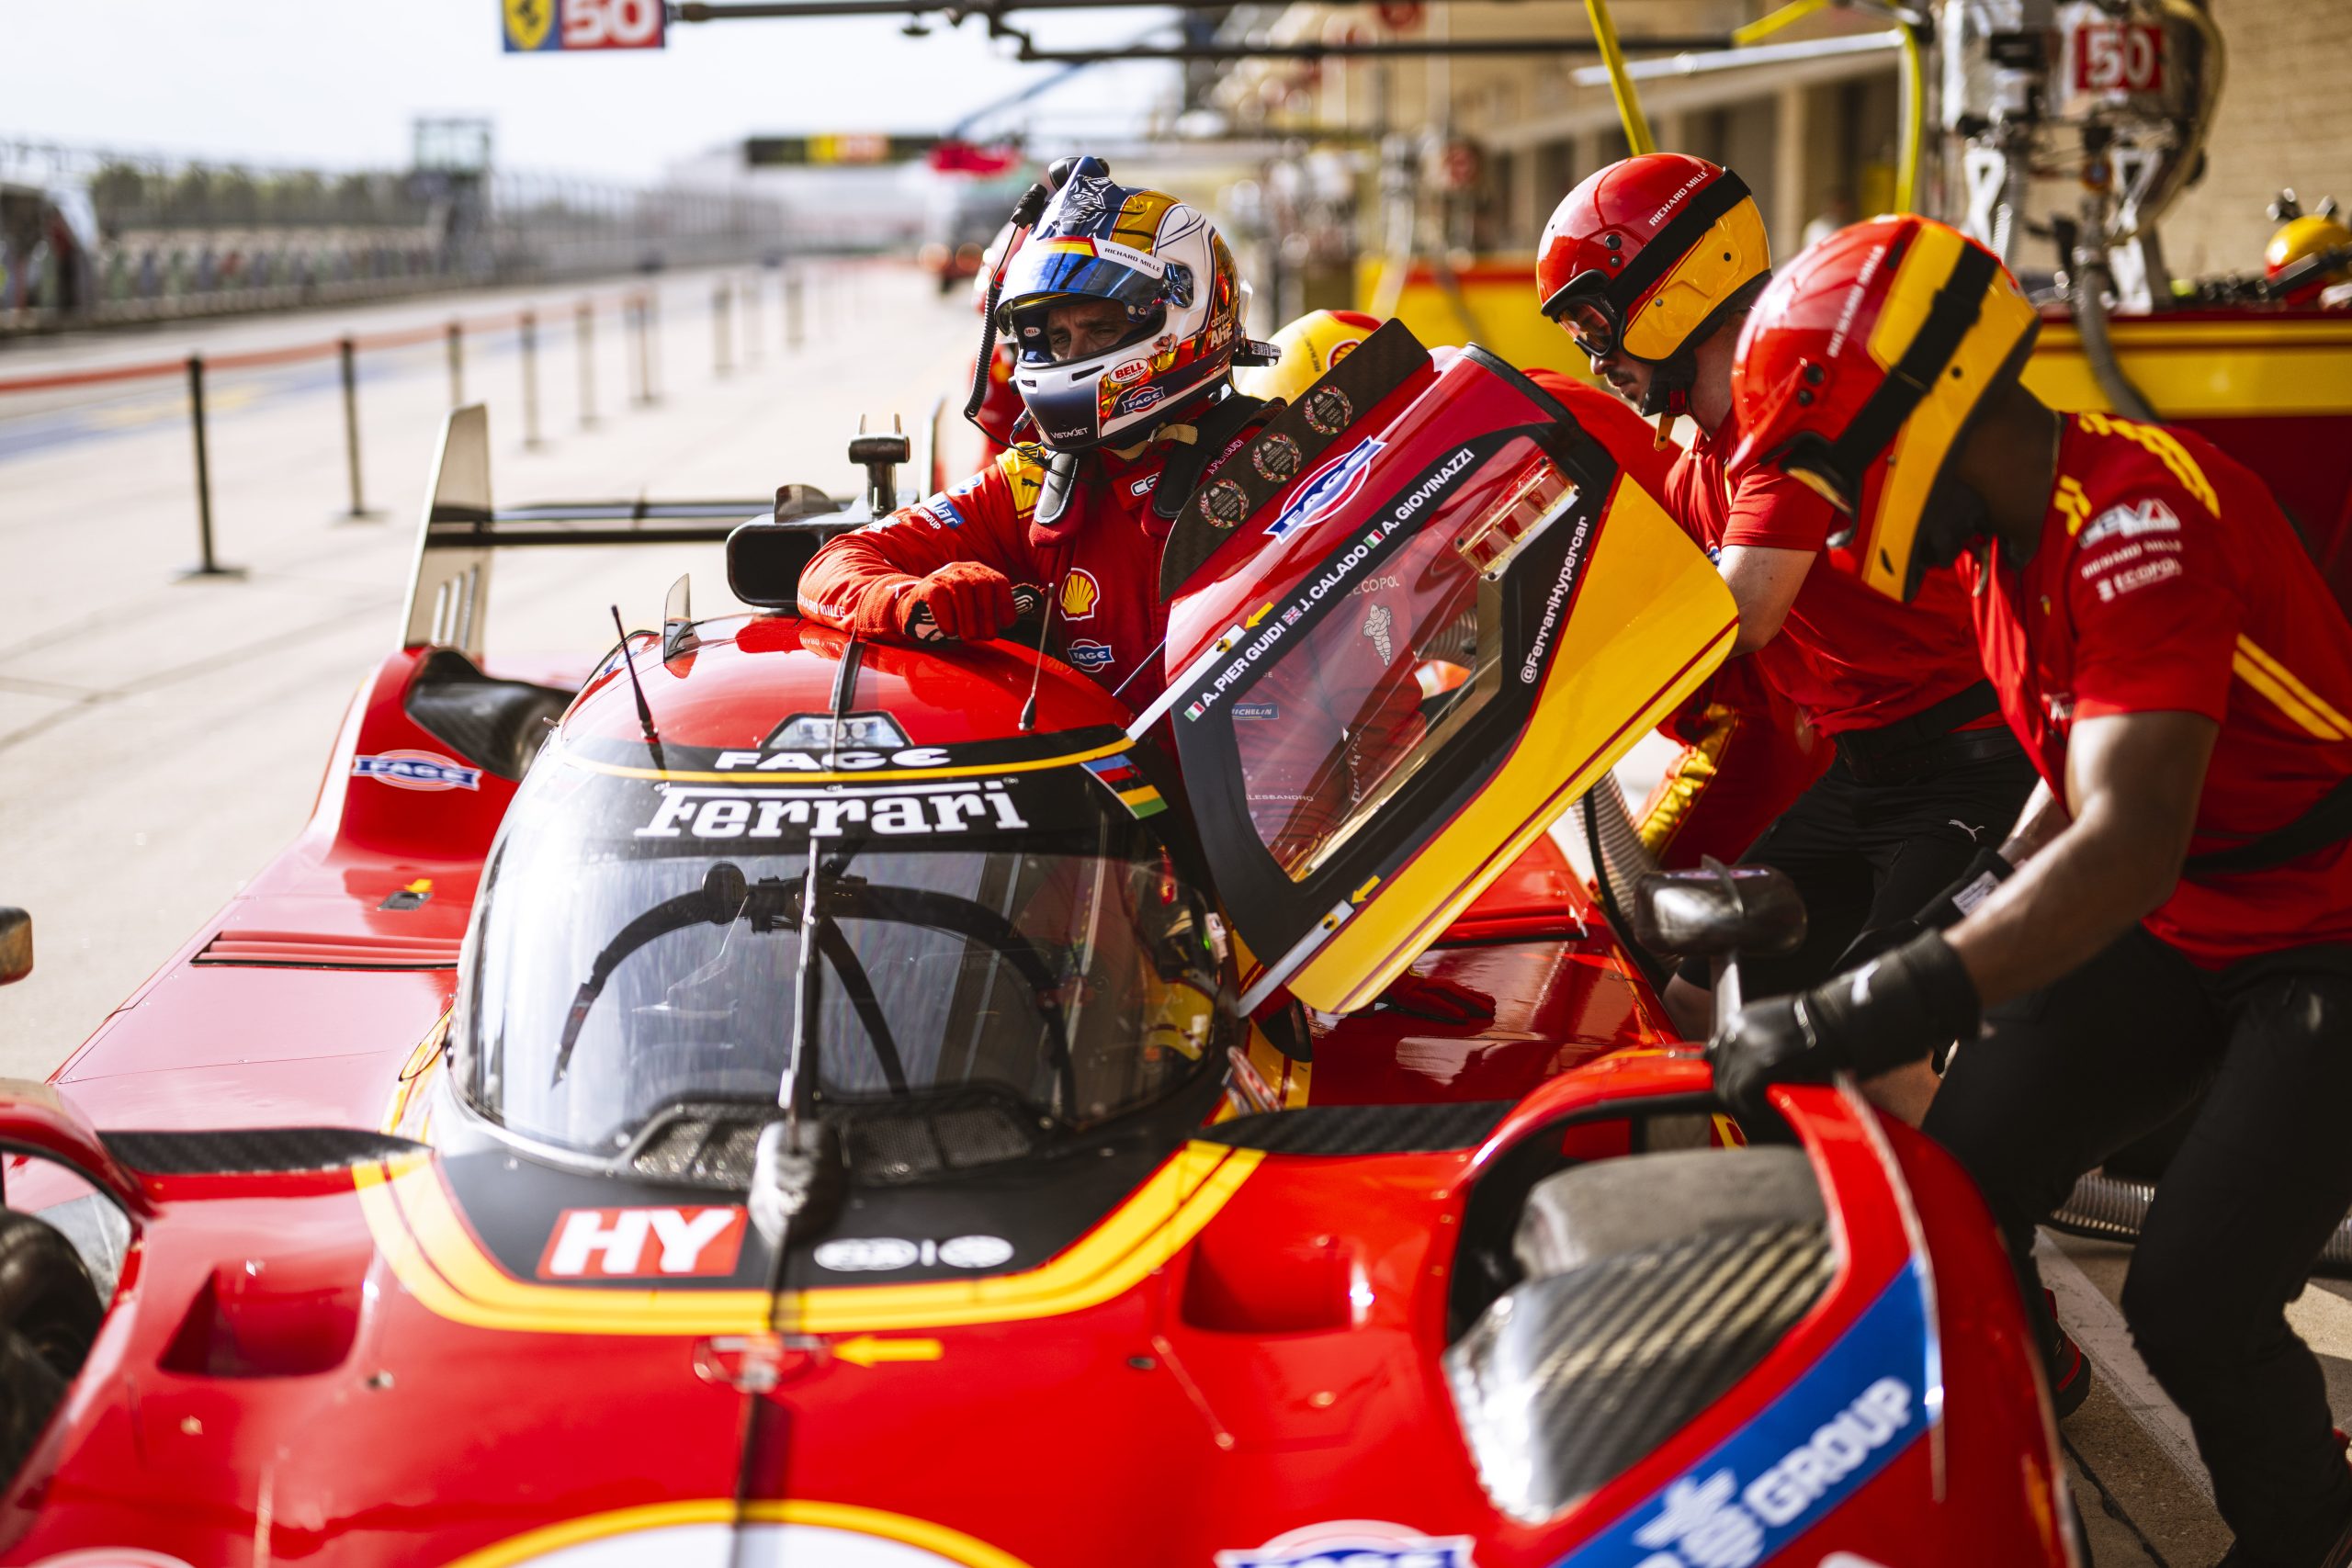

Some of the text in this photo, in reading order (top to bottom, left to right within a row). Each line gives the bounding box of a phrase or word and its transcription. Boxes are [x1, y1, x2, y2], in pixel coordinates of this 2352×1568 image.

[562, 0, 658, 42] 50
[2087, 29, 2154, 85] 50
[1648, 170, 1709, 227] RICHARD MILLE
[1104, 247, 1162, 274] RICHARD MILLE
[1024, 327, 1039, 335] BELL
[1114, 362, 1145, 379] BELL
[1128, 391, 1160, 408] FAGE
[1283, 446, 1366, 526] FAGE
[920, 508, 942, 530] GROUP
[1202, 692, 1219, 706] A.
[1213, 657, 1250, 692] PIER
[1245, 621, 1285, 660] GUIDI
[1299, 598, 1314, 611] J.
[1309, 544, 1368, 599] CALADO
[1381, 521, 1399, 535] A.
[1395, 447, 1474, 519] GIOVINAZZI
[1521, 515, 1589, 683] @FerrariHypercar
[714, 747, 952, 772] FAGE
[633, 780, 1029, 839] Ferrari
[550, 1209, 736, 1275] HY
[1742, 1376, 1913, 1527] GROUP
